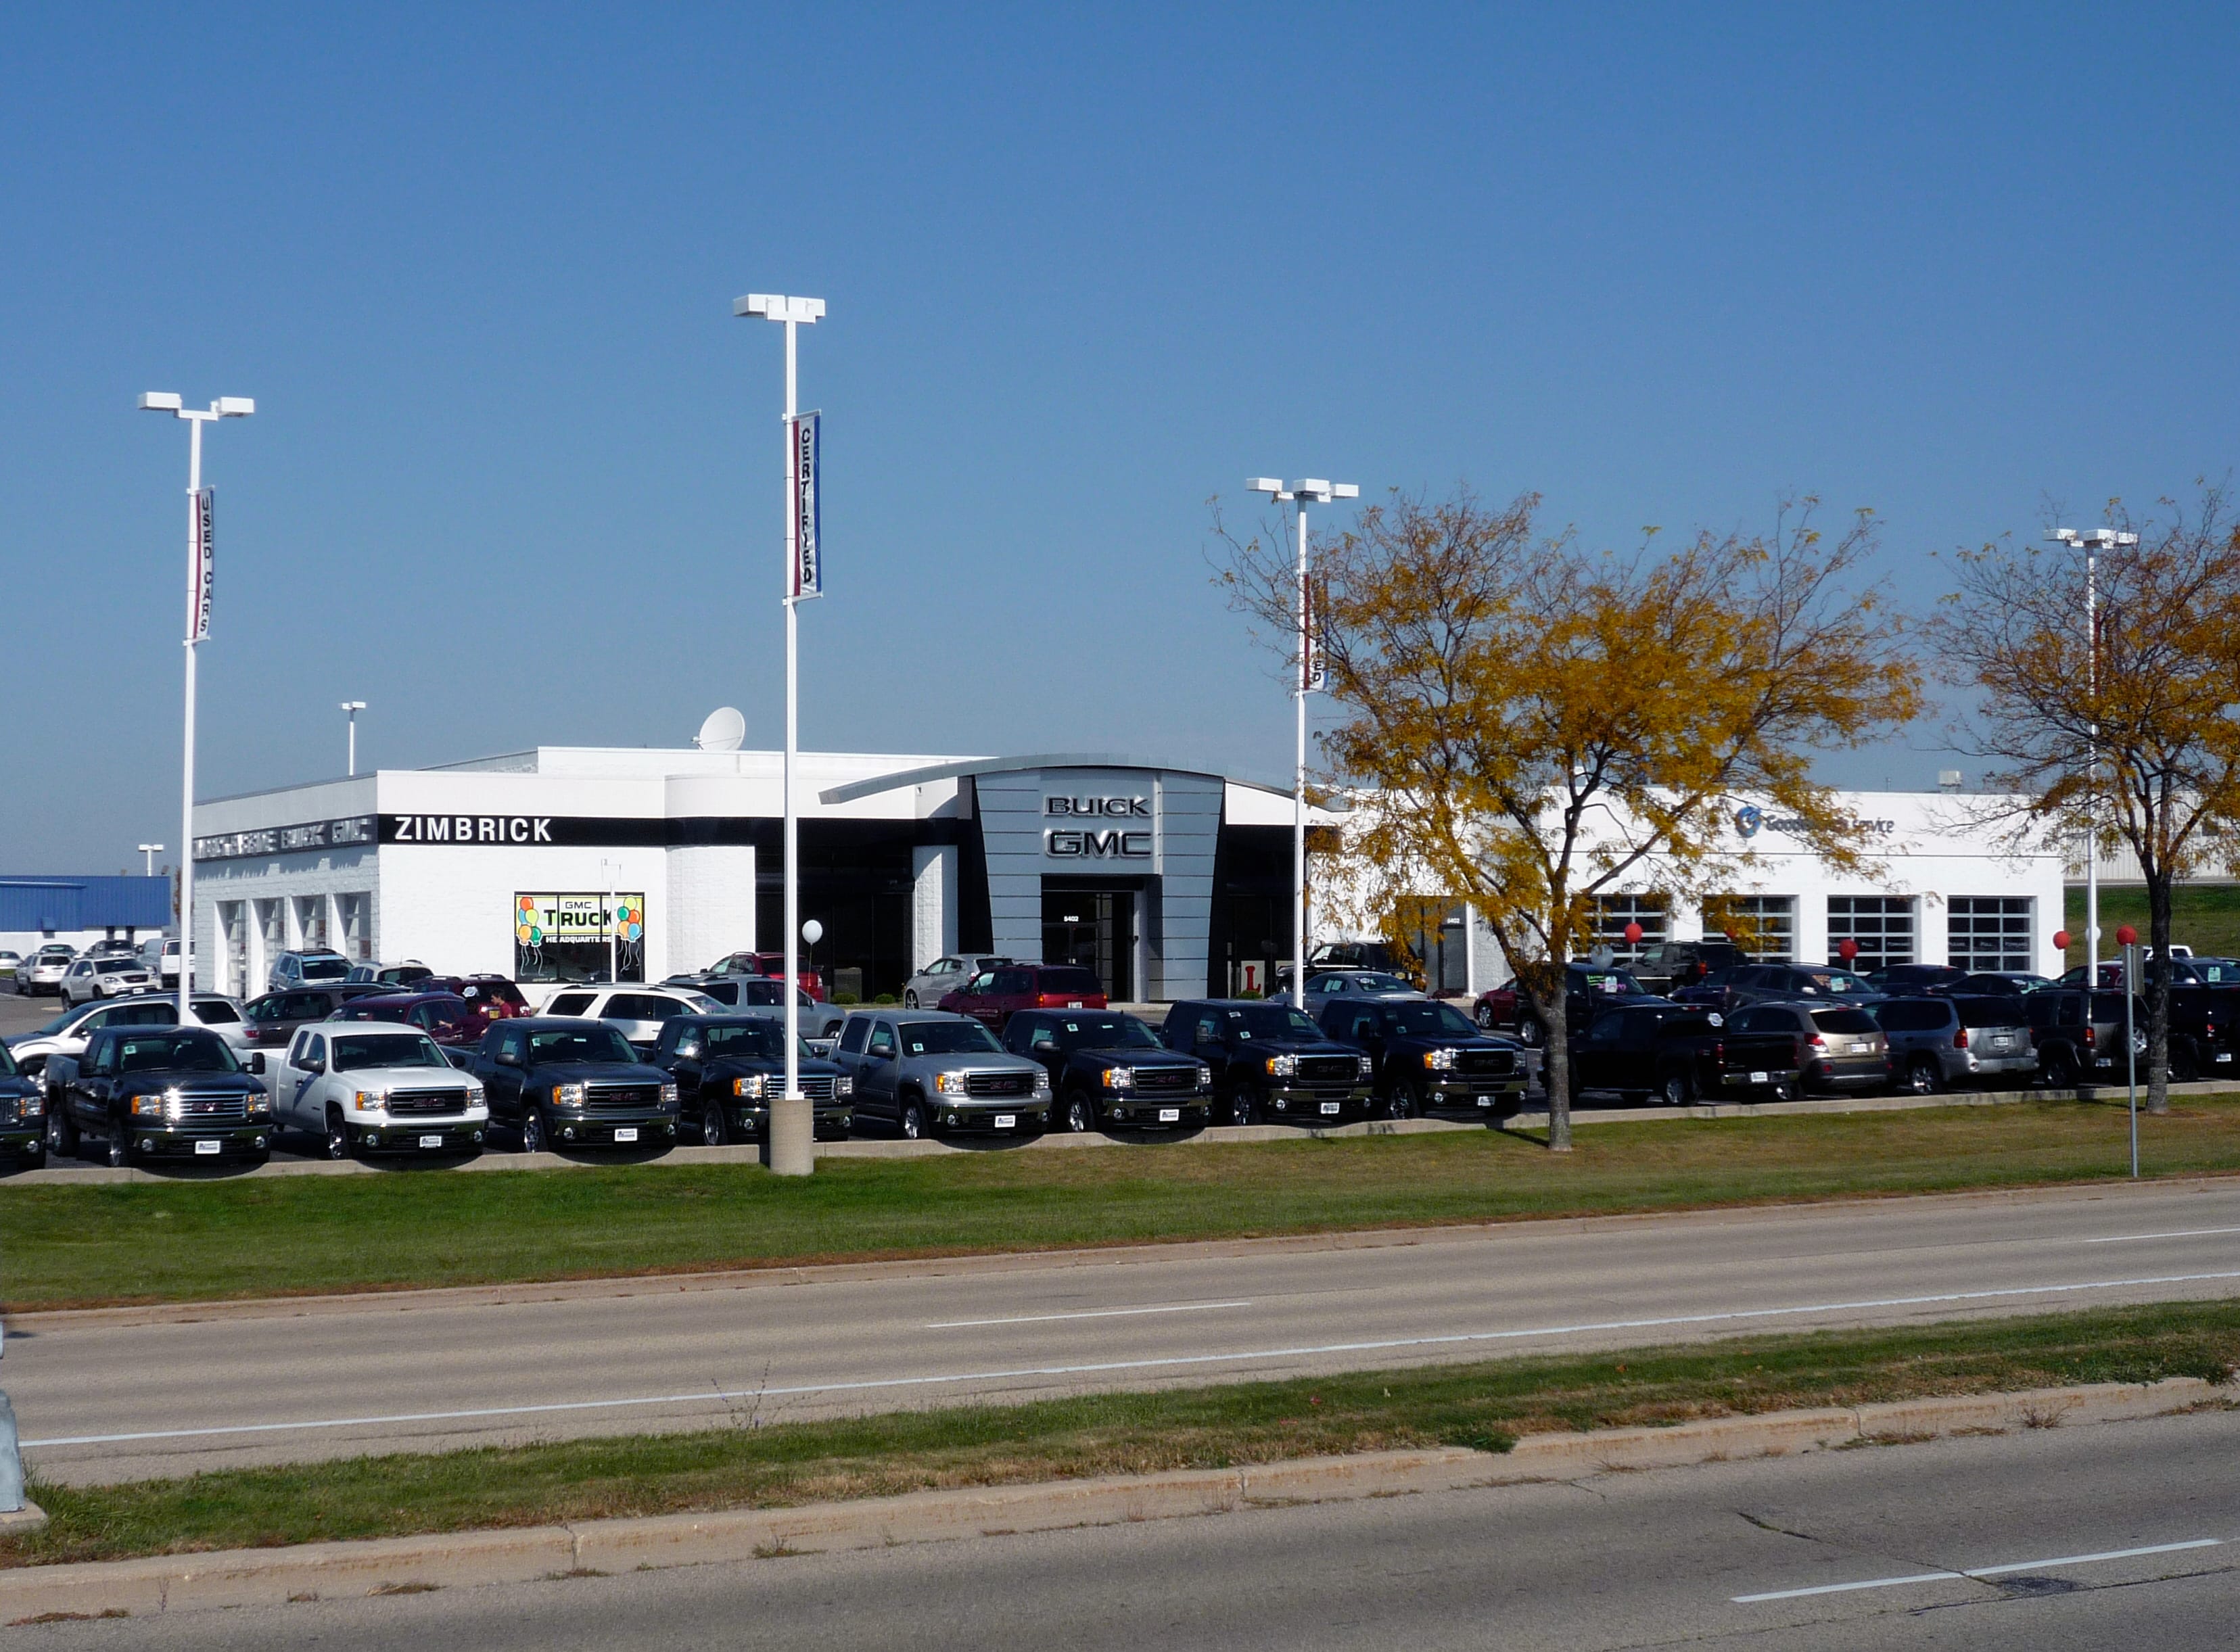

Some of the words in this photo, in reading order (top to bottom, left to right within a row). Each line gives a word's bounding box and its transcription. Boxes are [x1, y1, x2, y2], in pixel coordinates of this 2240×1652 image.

[801, 427, 812, 584] CERTIFIED
[202, 497, 212, 559] USED
[200, 571, 212, 632] CARS
[1045, 796, 1151, 816] BUICK
[394, 816, 553, 843] ZIMBRICK
[1045, 830, 1152, 857] GMC
[543, 909, 612, 926] TRUCK
[565, 901, 592, 910] GMC
[1245, 965, 1261, 993] L
